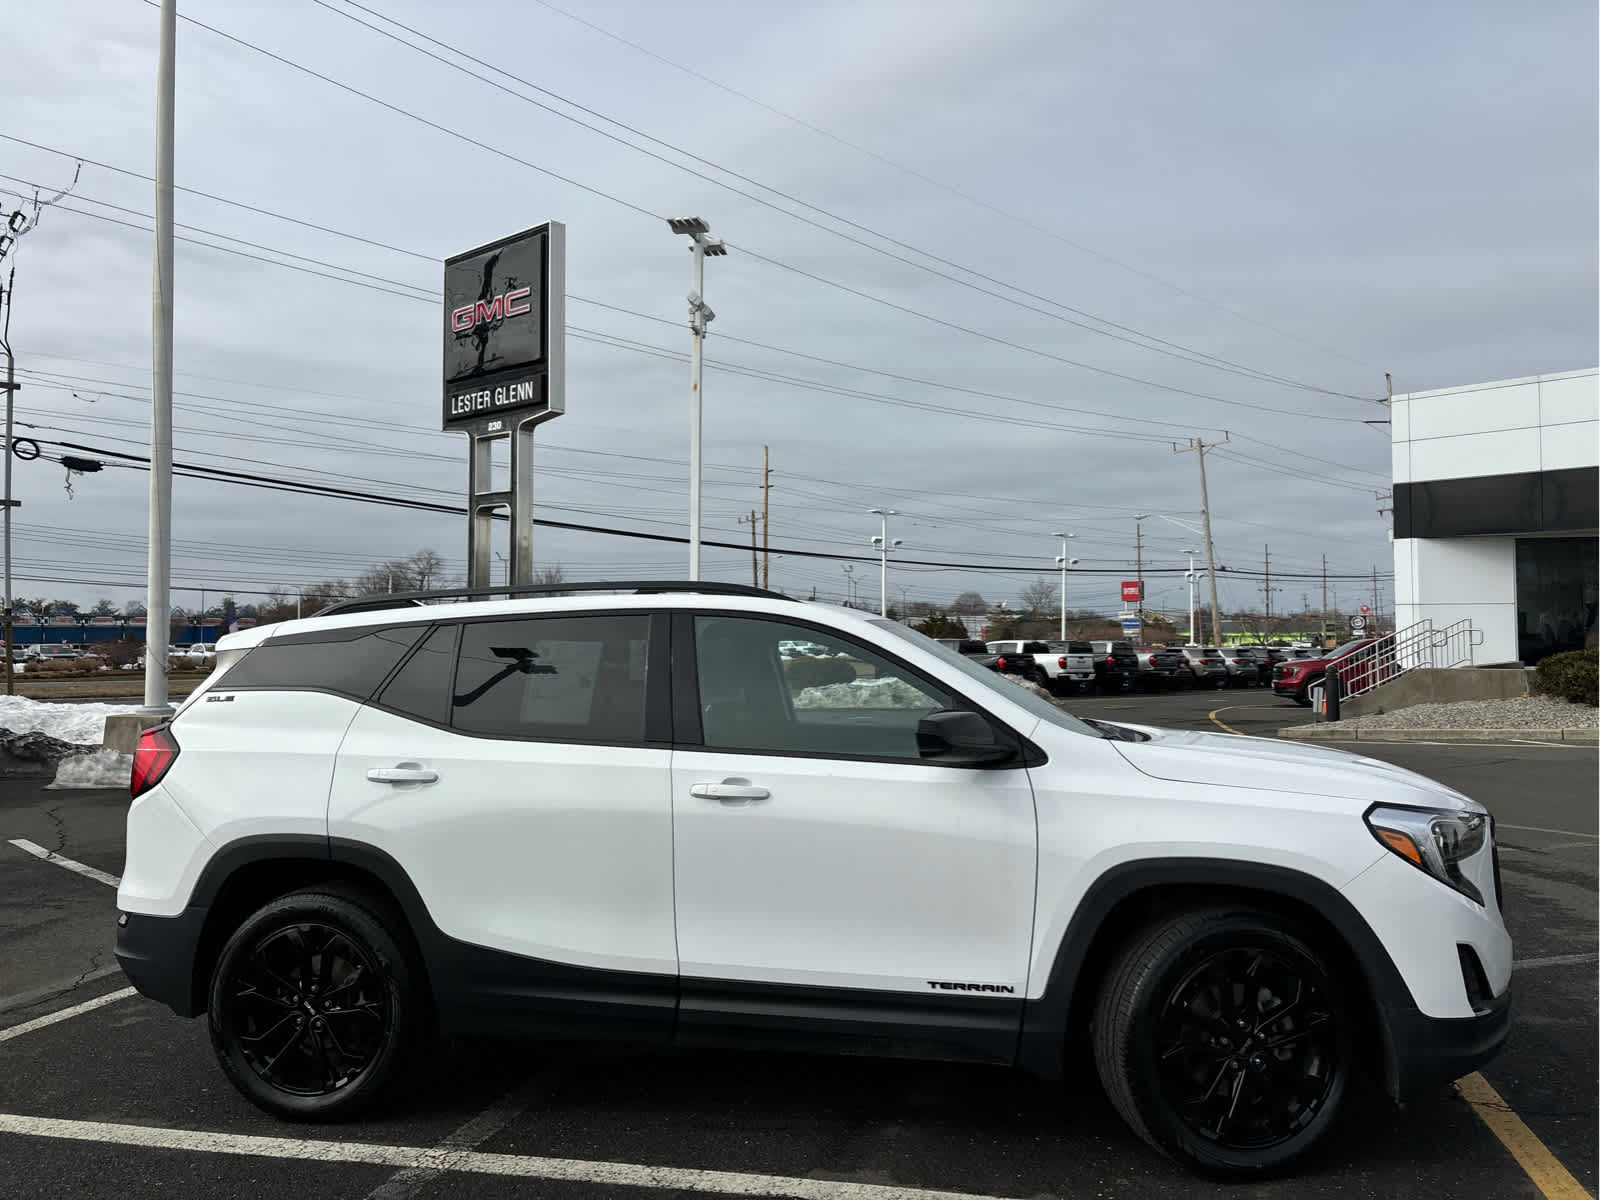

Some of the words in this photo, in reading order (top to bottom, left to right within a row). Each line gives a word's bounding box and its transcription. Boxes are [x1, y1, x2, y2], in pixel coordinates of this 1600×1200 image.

[452, 287, 530, 332] GMC
[452, 390, 491, 414] LESTER
[495, 381, 533, 406] GLENN
[488, 421, 502, 431] 230
[927, 981, 1014, 993] TERRAIN
